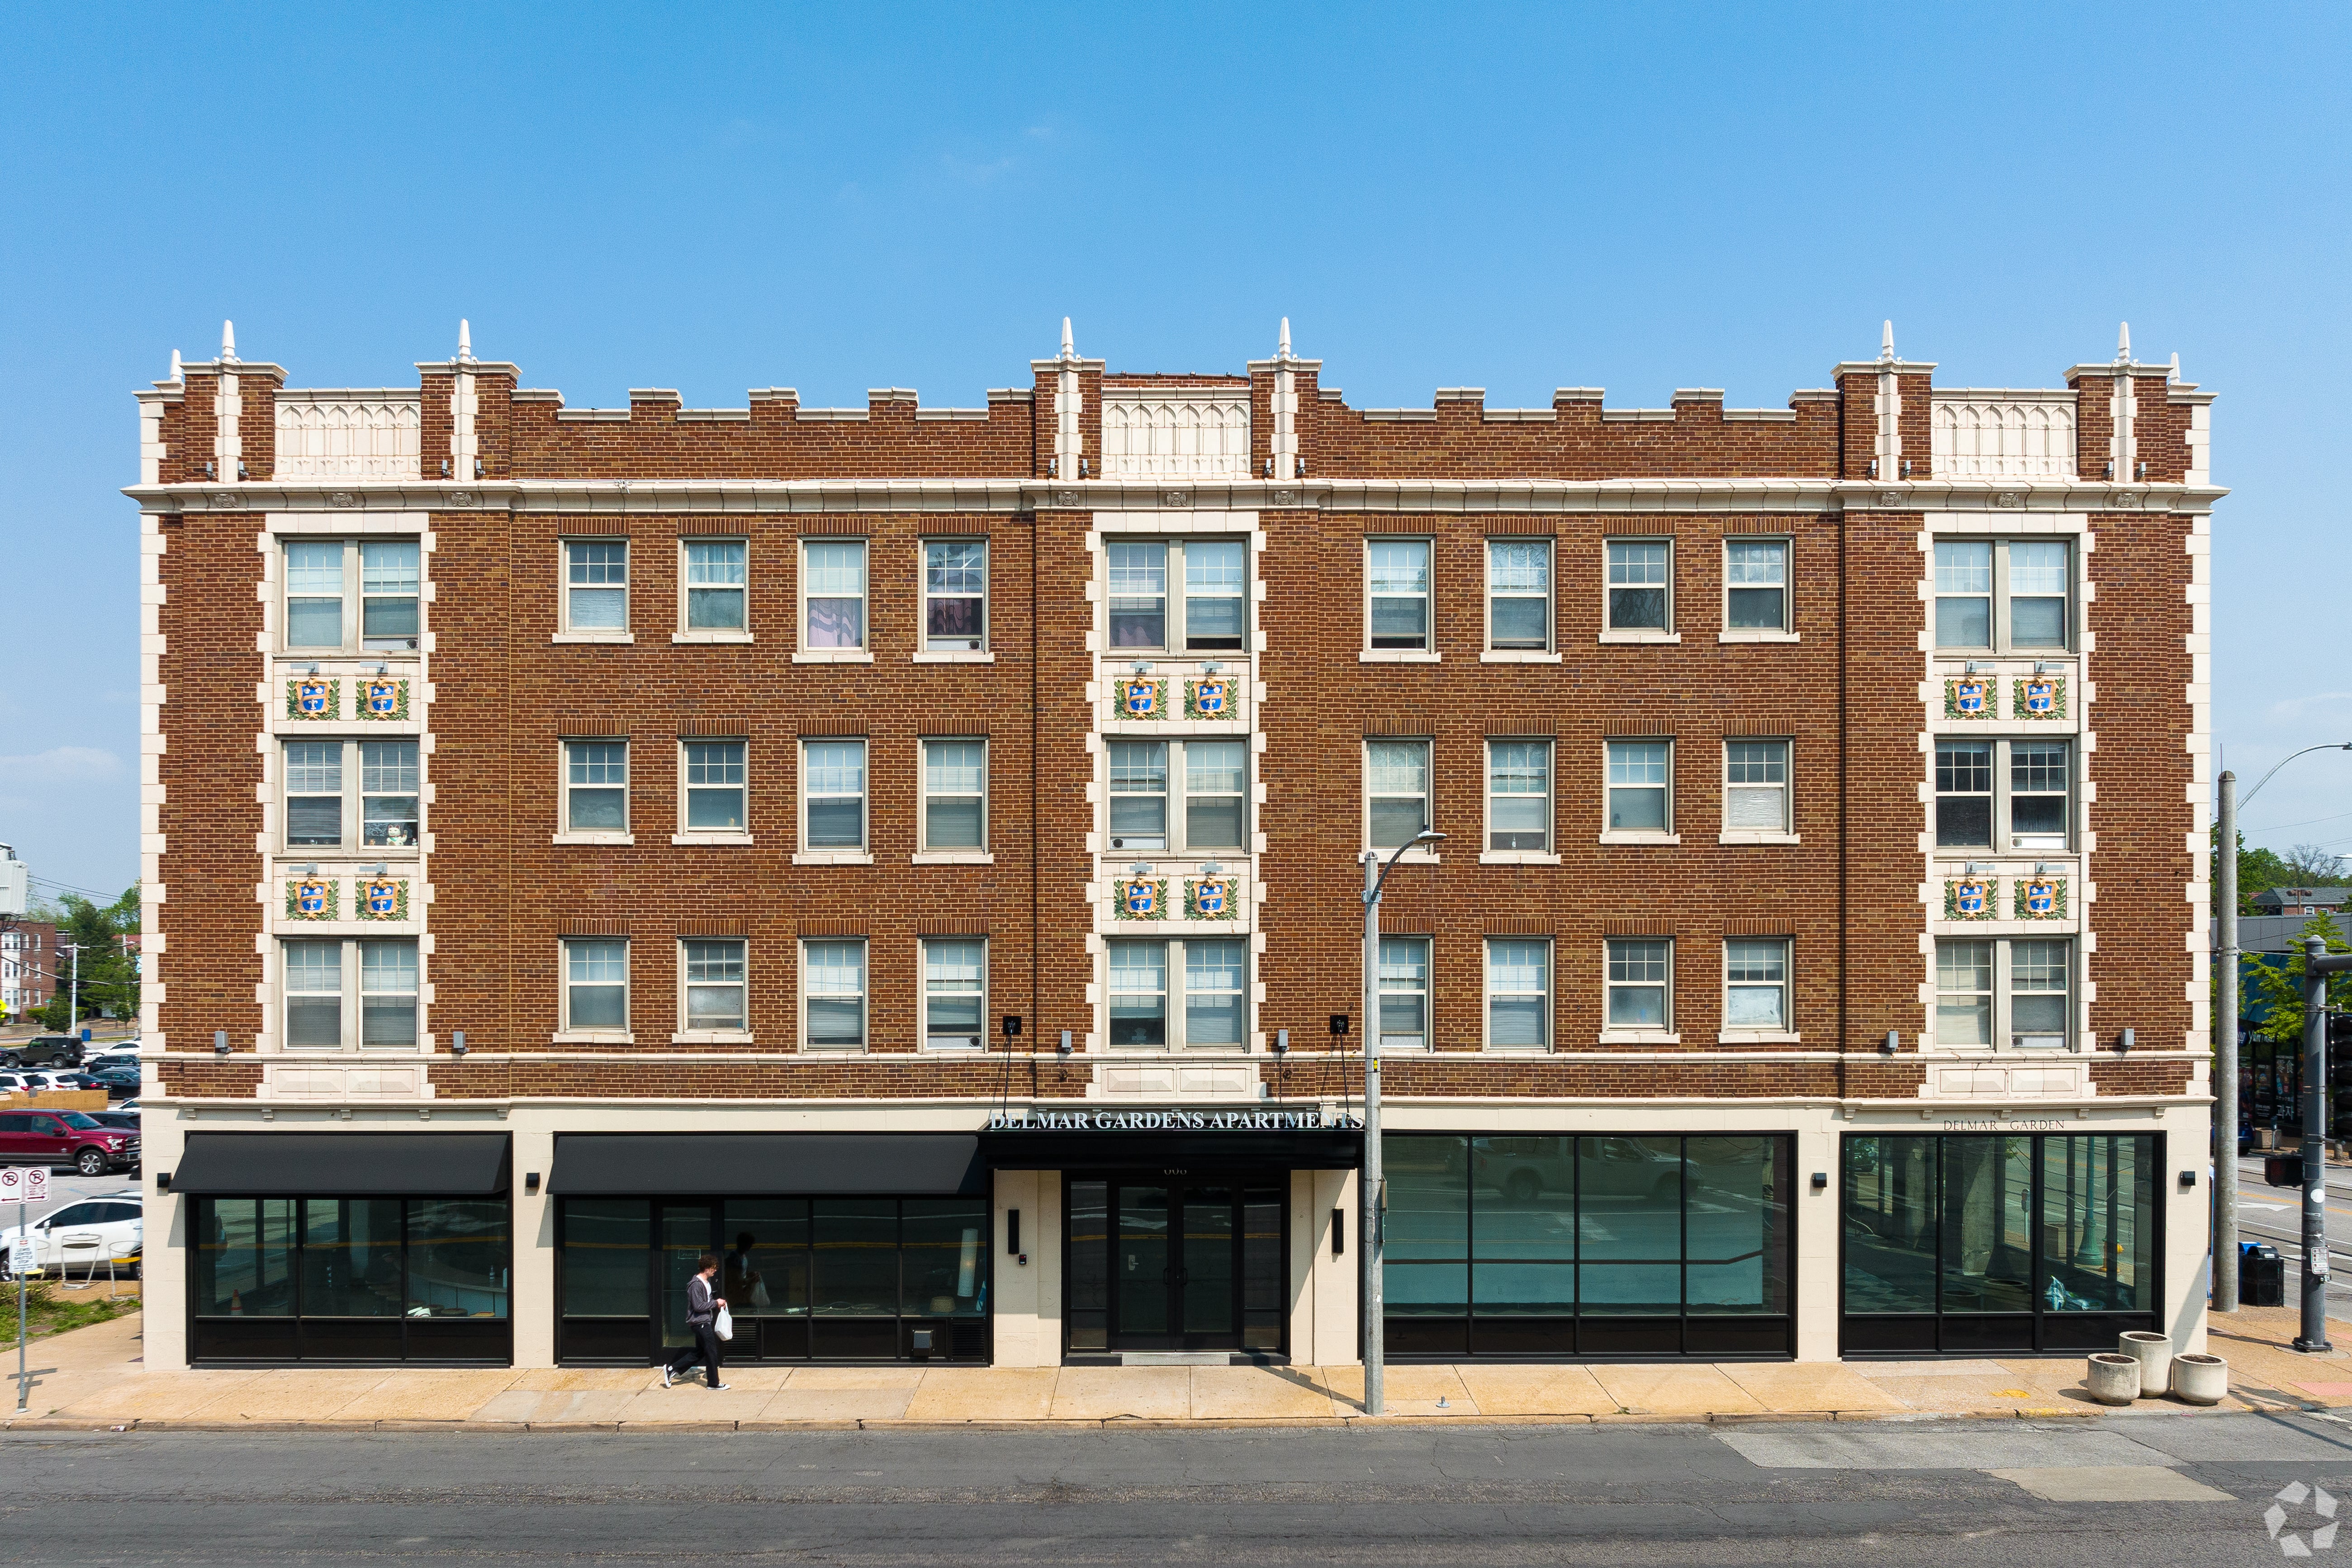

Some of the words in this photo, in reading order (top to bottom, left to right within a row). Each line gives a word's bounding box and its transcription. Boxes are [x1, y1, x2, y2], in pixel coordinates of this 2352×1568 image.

[2276, 1060, 2294, 1074] 零食
[2276, 1104, 2294, 1120] 과자
[990, 1112, 1090, 1129] DELMAR
[1095, 1112, 1204, 1129] GARDENS
[1210, 1112, 1364, 1129] APARTMENTS
[1944, 1120, 1998, 1130] DELMAR
[2010, 1119, 2065, 1130] GARDEN
